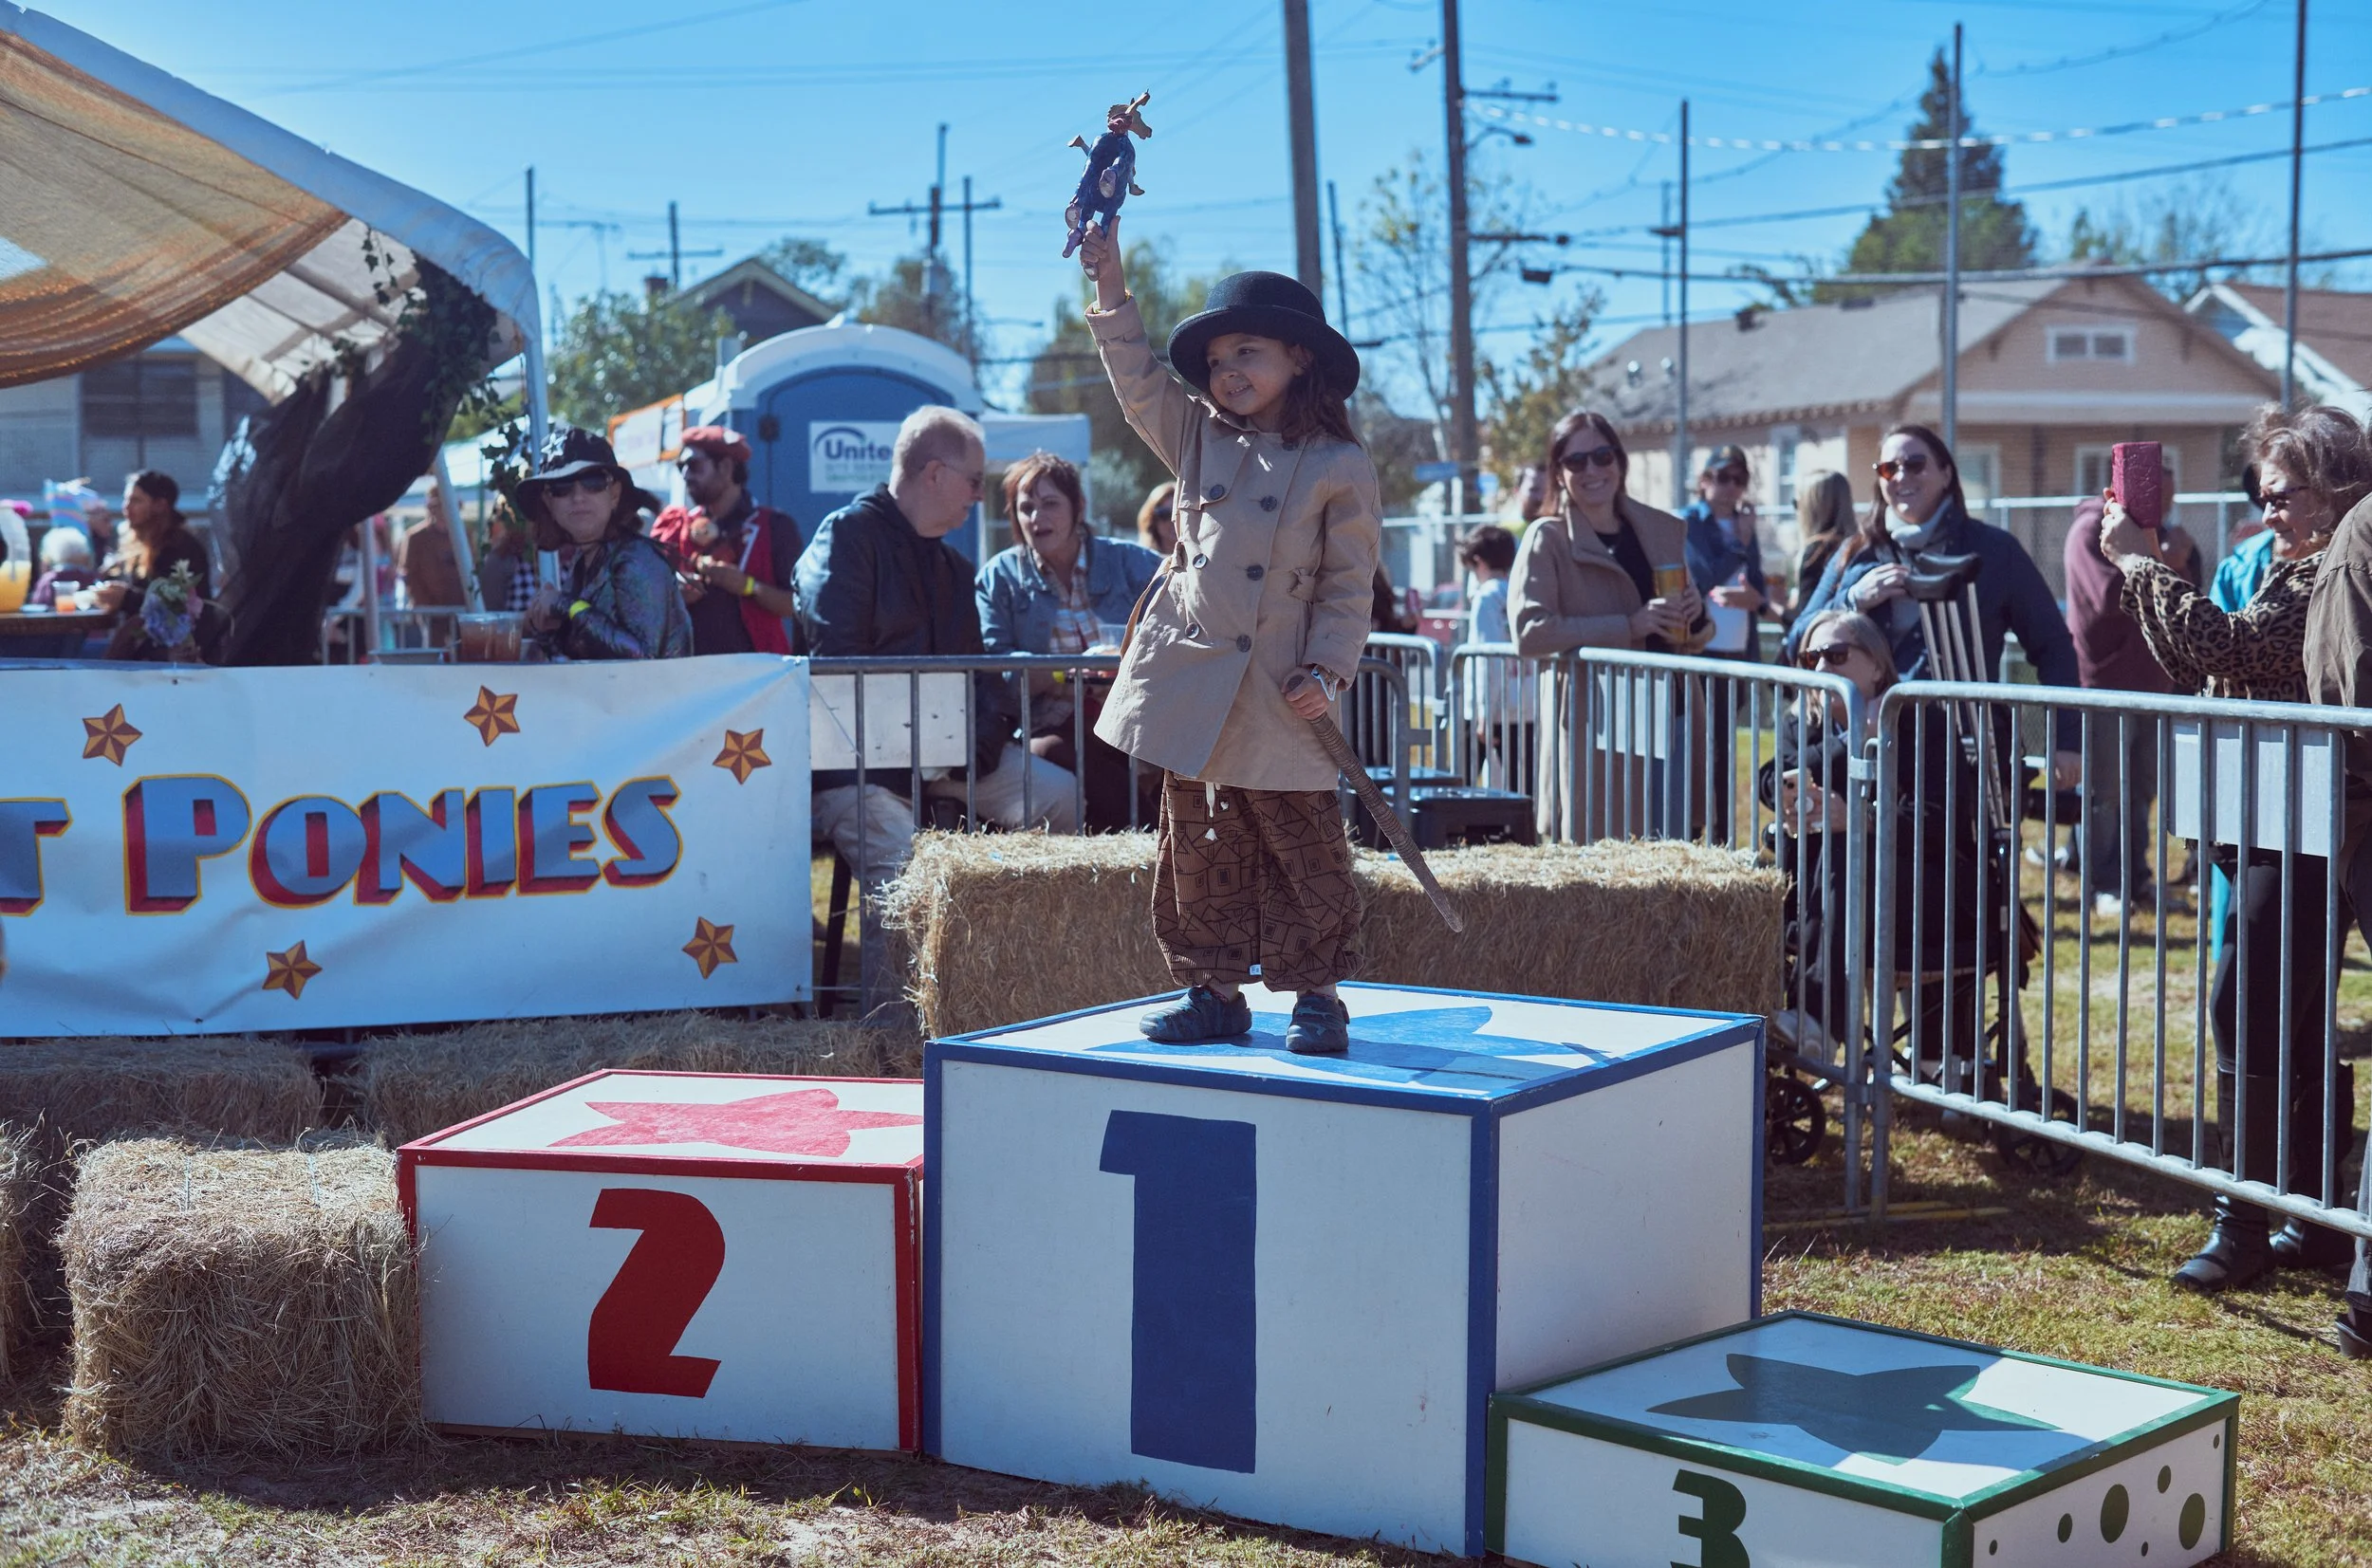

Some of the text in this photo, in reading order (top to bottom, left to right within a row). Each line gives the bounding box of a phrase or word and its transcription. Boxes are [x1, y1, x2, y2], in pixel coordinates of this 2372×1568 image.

[121, 773, 683, 915] PONIES
[587, 1189, 725, 1398] 2
[1100, 1111, 1256, 1473] 1
[1670, 1468, 1751, 1568] 3
